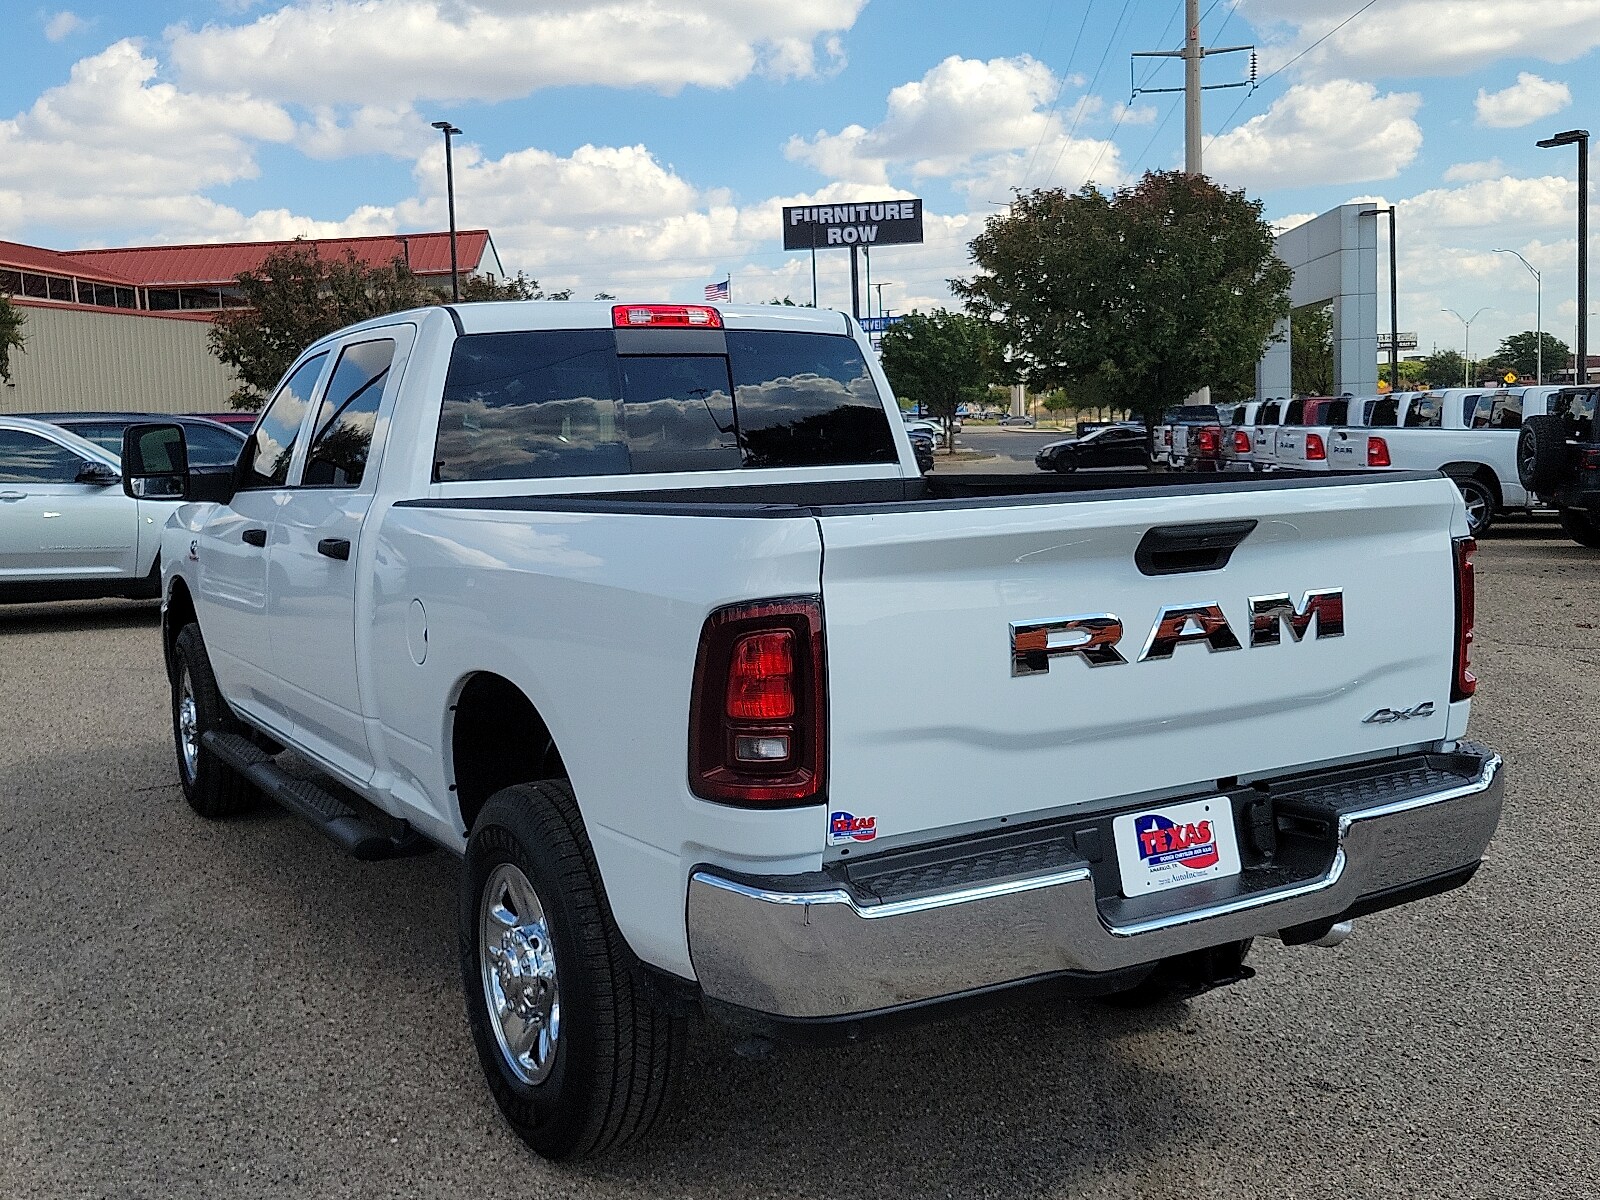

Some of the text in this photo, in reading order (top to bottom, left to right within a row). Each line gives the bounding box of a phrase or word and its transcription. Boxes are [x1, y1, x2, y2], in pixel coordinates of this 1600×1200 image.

[790, 202, 915, 226] FURNITURE
[827, 225, 878, 244] ROW
[1008, 586, 1345, 678] RAM
[833, 816, 876, 831] TEXAS
[1141, 820, 1212, 855] TEXAS
